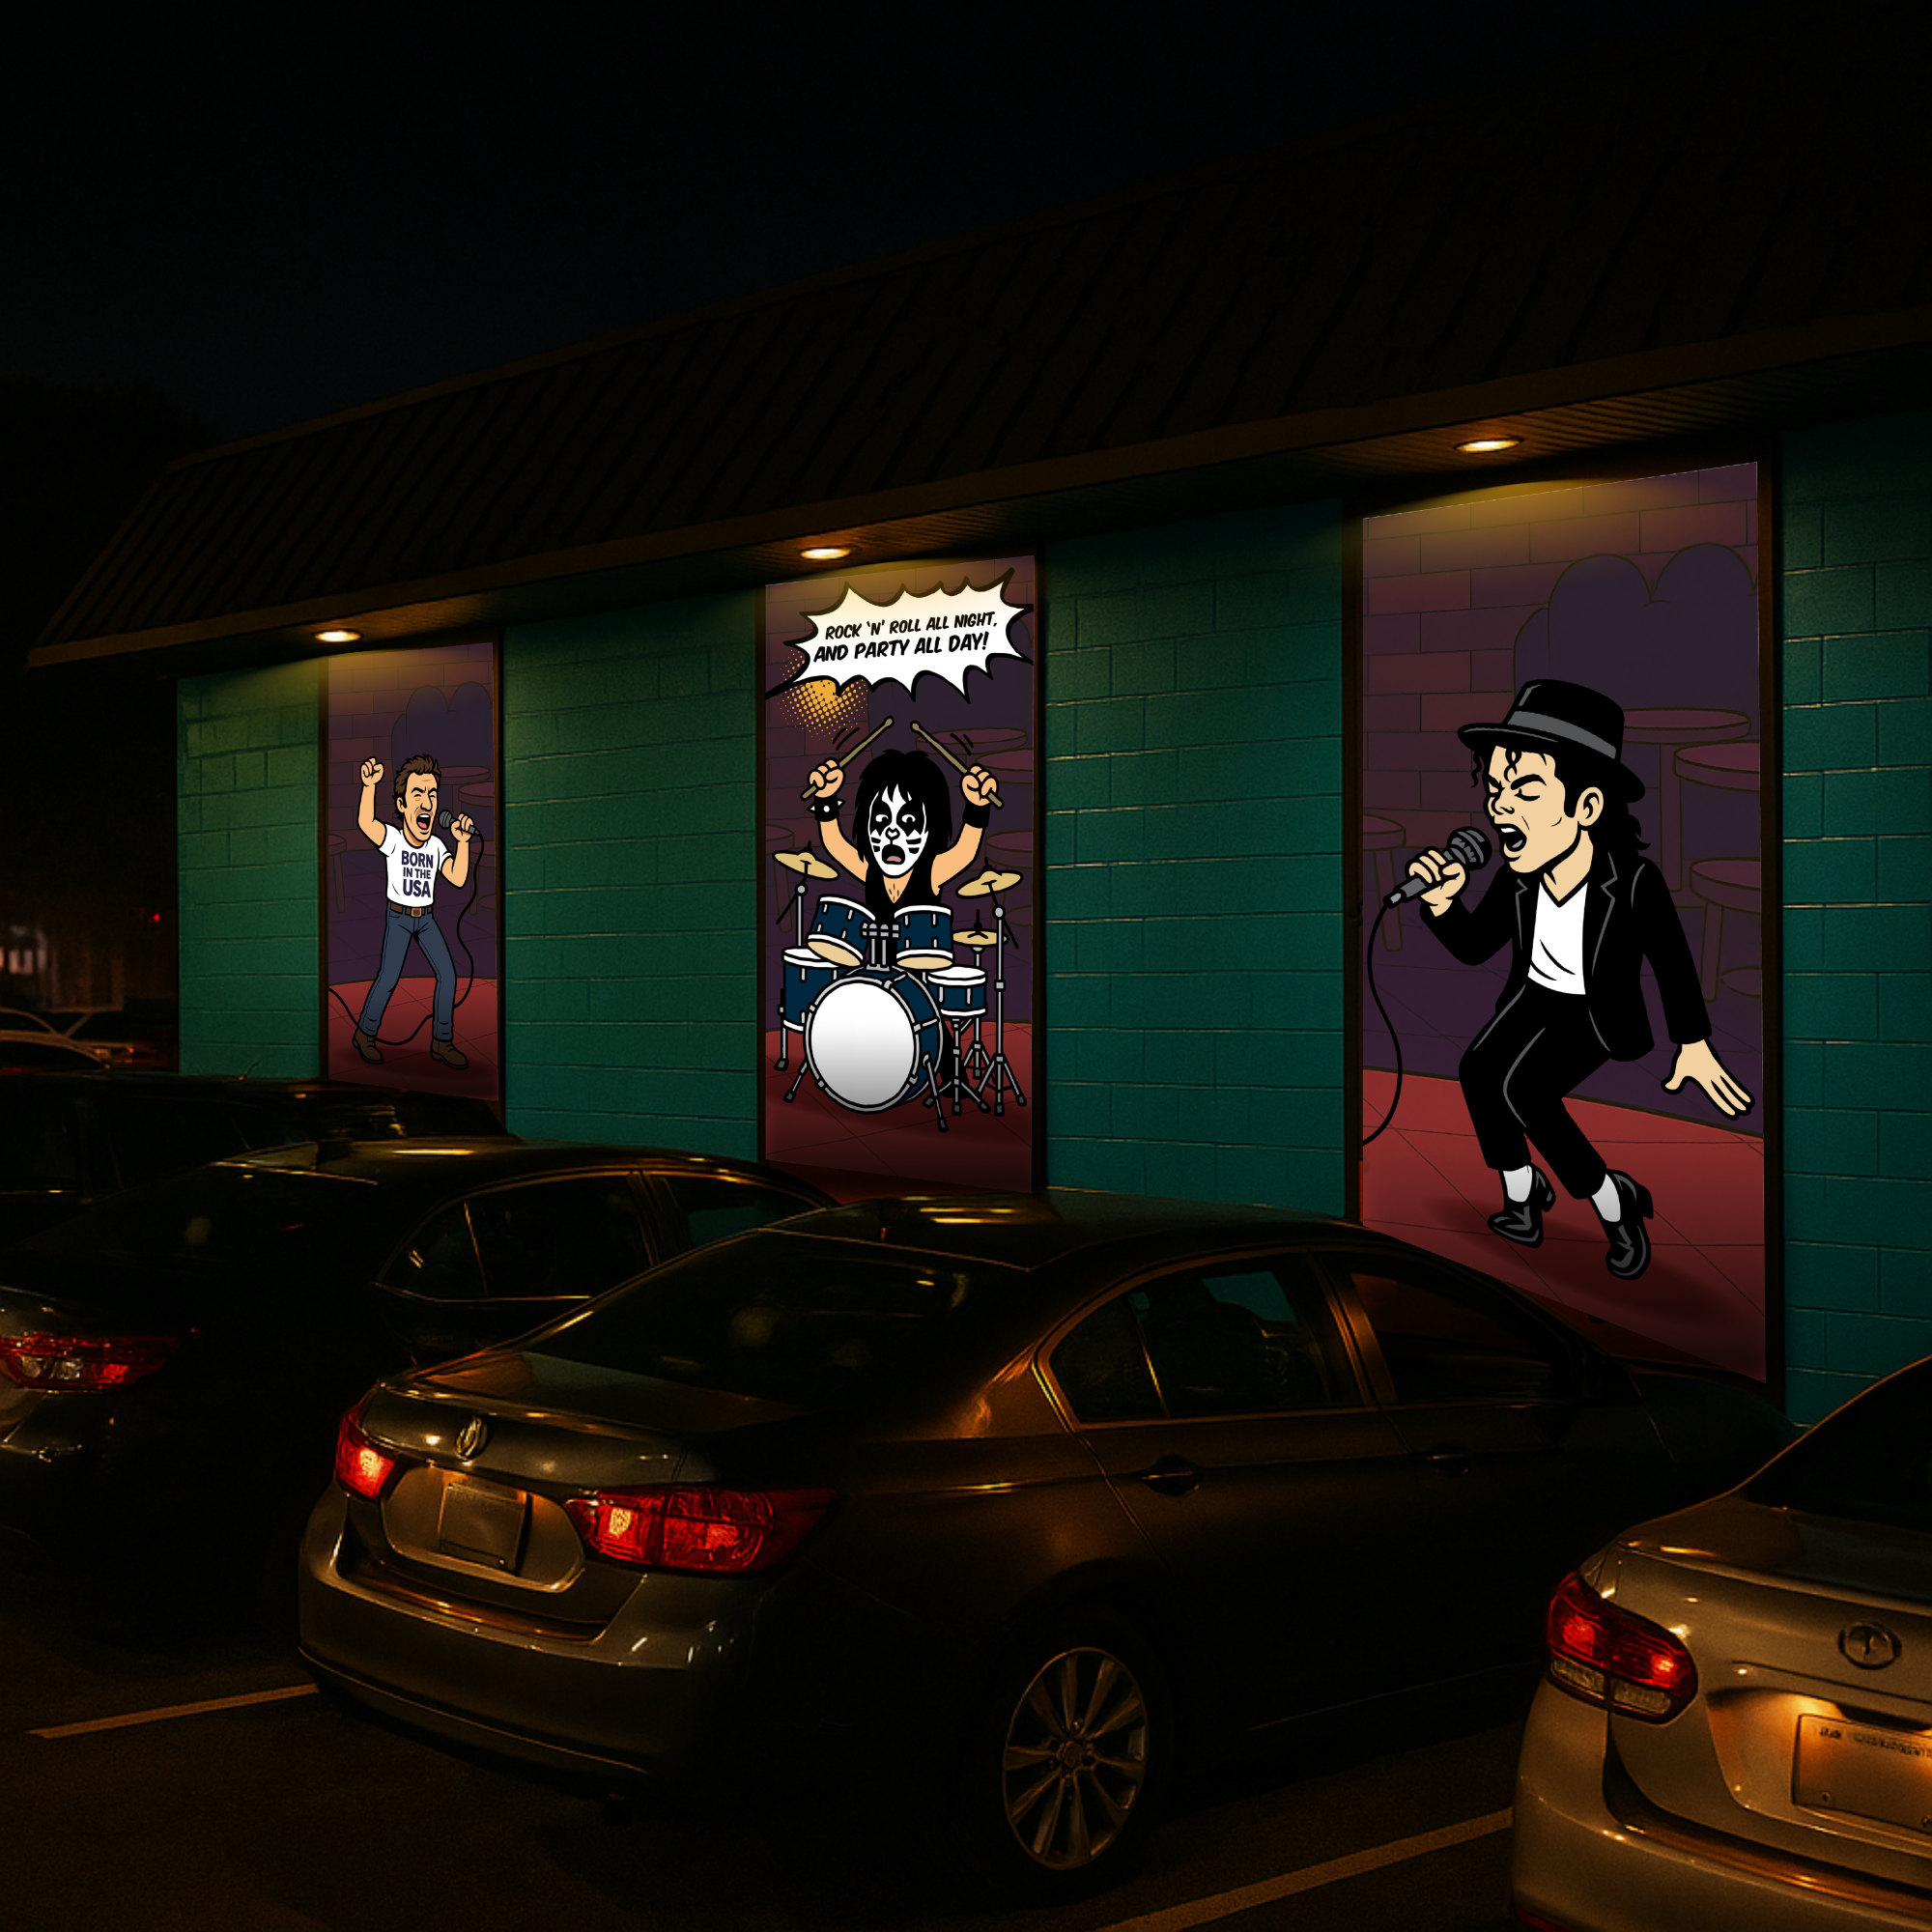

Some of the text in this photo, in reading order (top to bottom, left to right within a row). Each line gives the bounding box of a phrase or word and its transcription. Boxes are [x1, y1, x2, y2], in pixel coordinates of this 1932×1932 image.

[825, 623, 862, 640] ROCK
[889, 618, 922, 634] ROLL
[925, 614, 950, 631] ALL
[953, 611, 999, 628] NIGHT,
[813, 631, 990, 663] AND PARTY ALL DAY!
[401, 850, 433, 868] BORN
[403, 867, 432, 879] IN THE
[403, 878, 432, 898] USA
